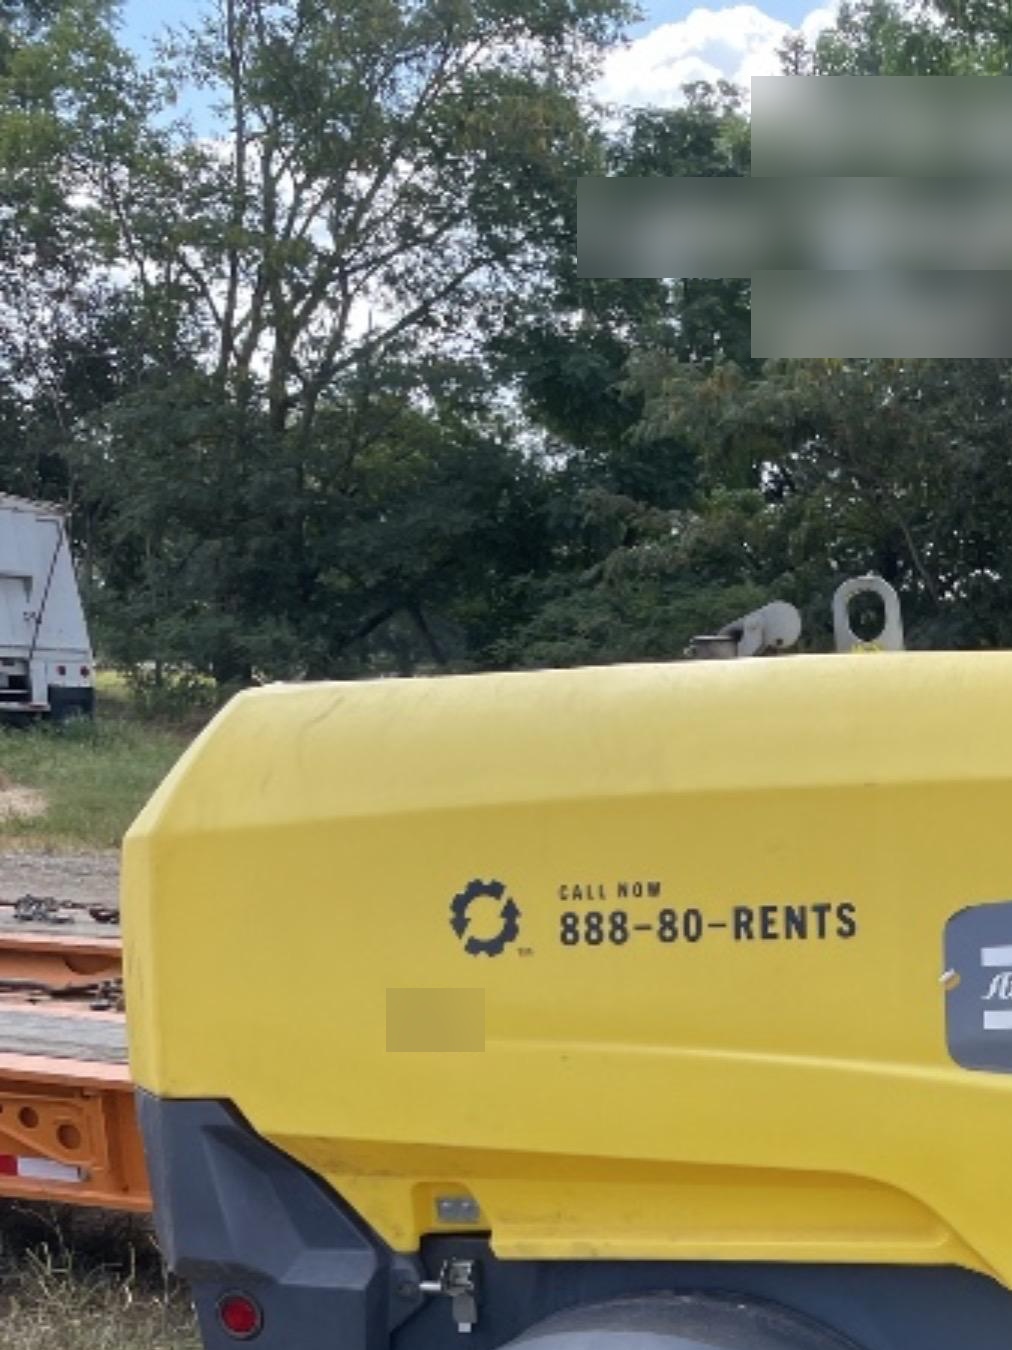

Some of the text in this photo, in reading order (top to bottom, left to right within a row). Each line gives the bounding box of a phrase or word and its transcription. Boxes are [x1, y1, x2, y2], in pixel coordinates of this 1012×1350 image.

[559, 881, 661, 900] CALL NOW
[560, 903, 857, 946] 888-80-RENTS
